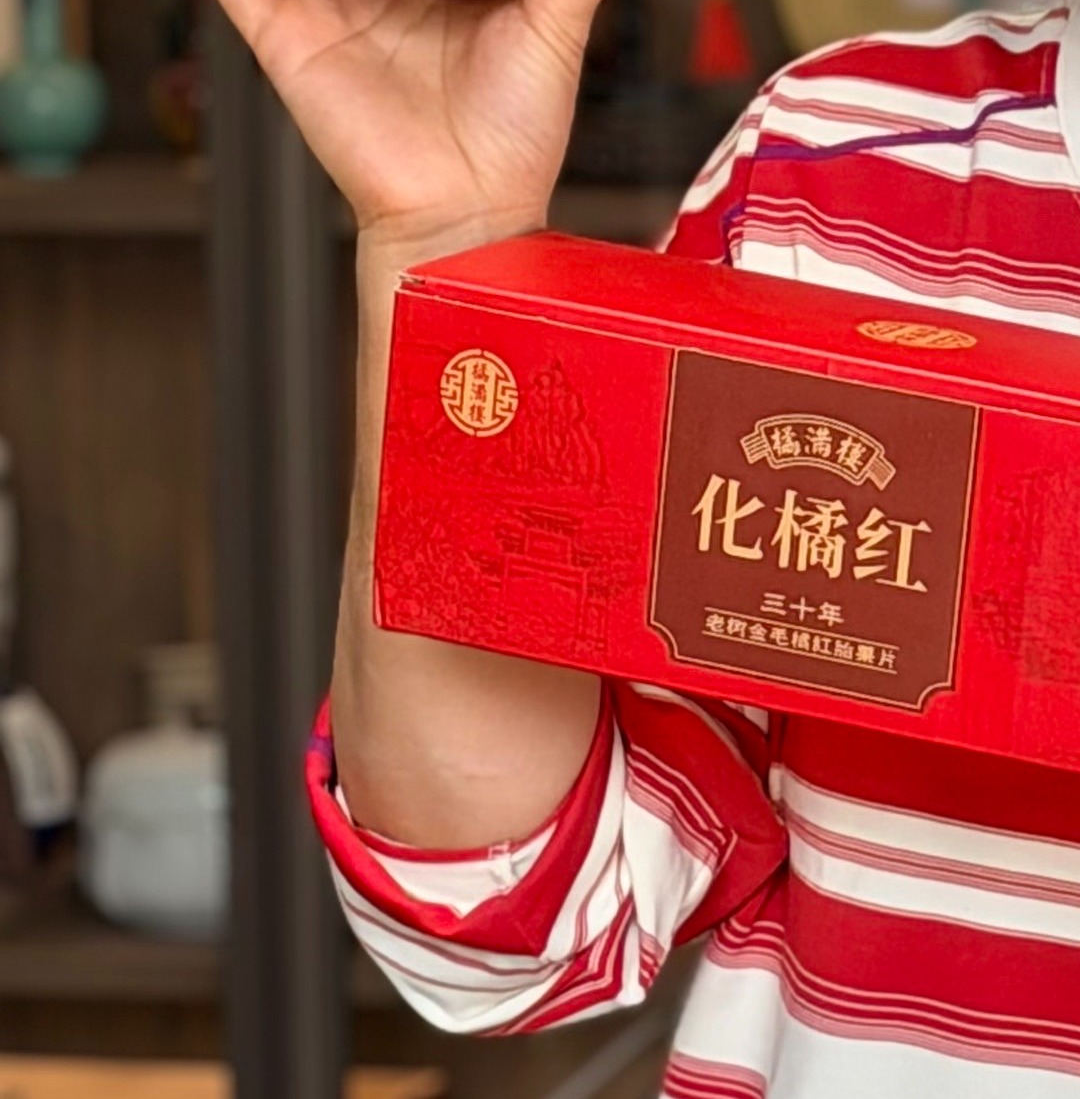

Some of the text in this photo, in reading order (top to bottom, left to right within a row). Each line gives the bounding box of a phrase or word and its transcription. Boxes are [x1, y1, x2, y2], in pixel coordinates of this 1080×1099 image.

[691, 473, 933, 593] 化橘红
[759, 592, 845, 627] 三十年
